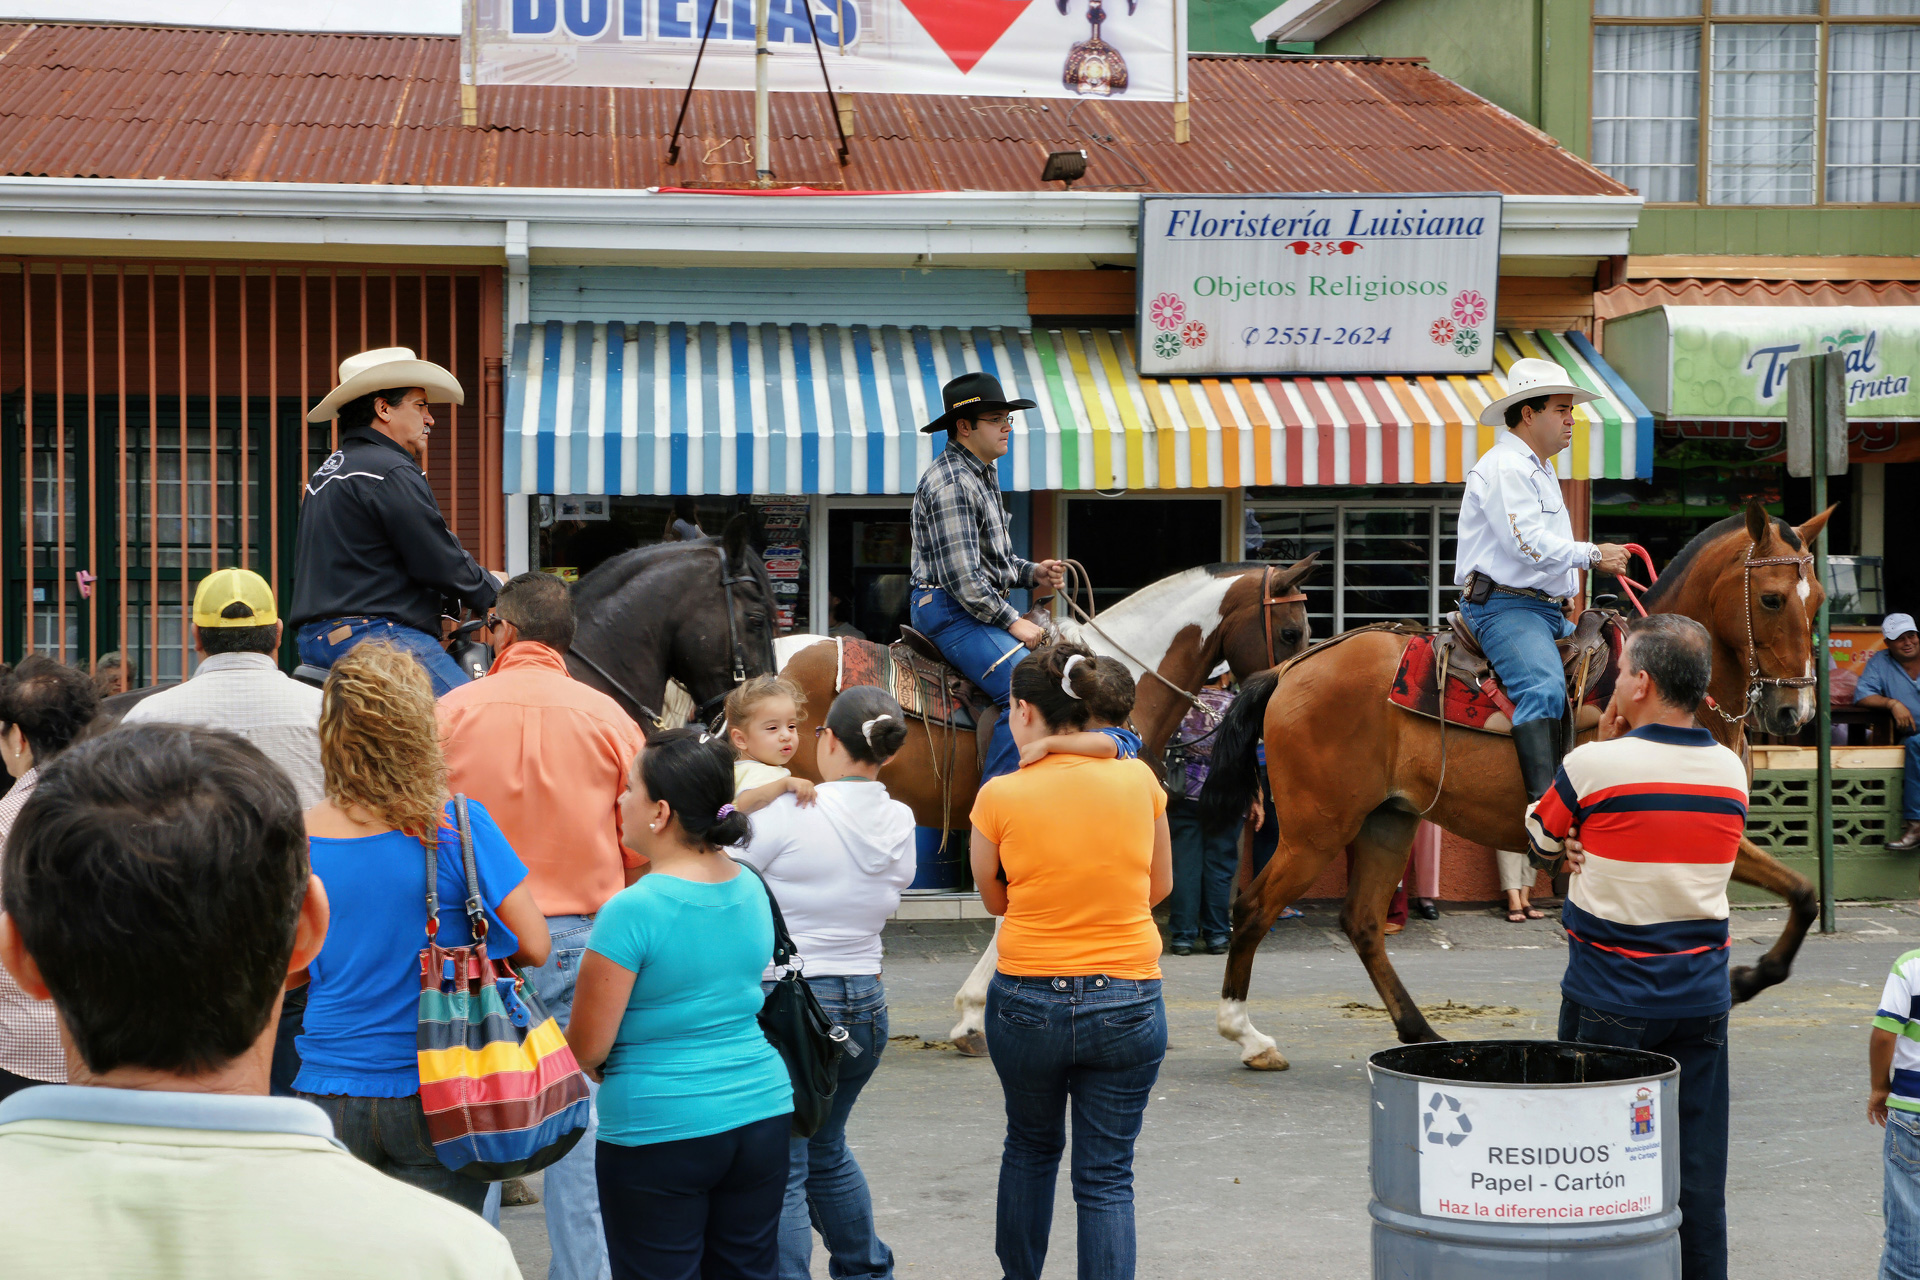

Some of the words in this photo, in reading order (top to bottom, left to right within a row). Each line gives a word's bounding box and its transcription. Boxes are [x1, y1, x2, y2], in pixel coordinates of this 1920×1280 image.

[1165, 209, 1331, 237] Floristería
[1345, 208, 1485, 237] Luisiana
[1193, 275, 1296, 302] Objetos
[1308, 275, 1448, 302] Religiosos
[1264, 326, 1393, 346] 2551-2624
[1849, 376, 1909, 404] fruta
[1488, 1144, 1610, 1165] RESIDUOS
[1624, 1141, 1660, 1153] Municipalidad
[1471, 1172, 1533, 1195] Papel
[1554, 1171, 1625, 1192] Cartón
[1439, 1198, 1470, 1215] Haz
[1474, 1202, 1490, 1217] la
[1494, 1204, 1584, 1218] diferencia
[1588, 1196, 1652, 1217] recicla!!!
